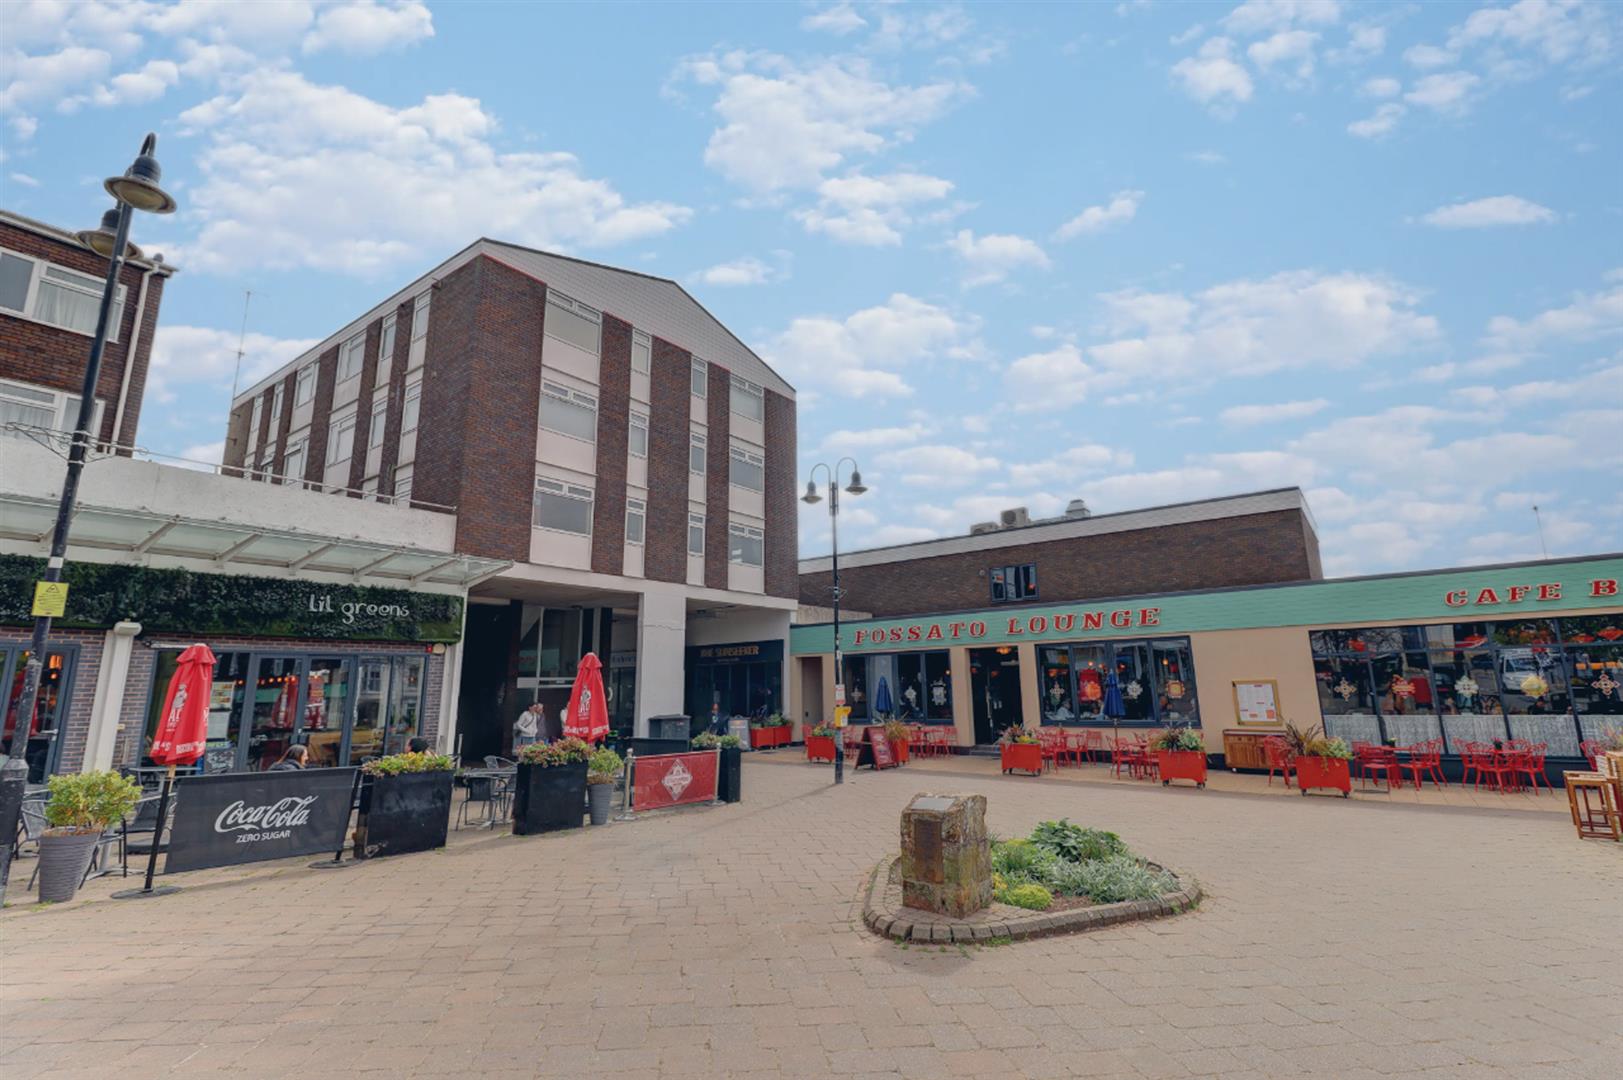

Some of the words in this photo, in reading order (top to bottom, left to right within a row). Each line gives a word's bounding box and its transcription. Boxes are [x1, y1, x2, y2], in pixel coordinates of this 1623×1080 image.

[1444, 583, 1562, 606] CAFE
[1589, 578, 1619, 597] B
[341, 602, 410, 625] greens
[855, 621, 986, 645] FOSSATO
[1007, 607, 1161, 635] LOUNGE
[214, 795, 319, 833] Coca-Cola
[235, 833, 260, 843] ZERO
[261, 830, 291, 841] SUGAR
